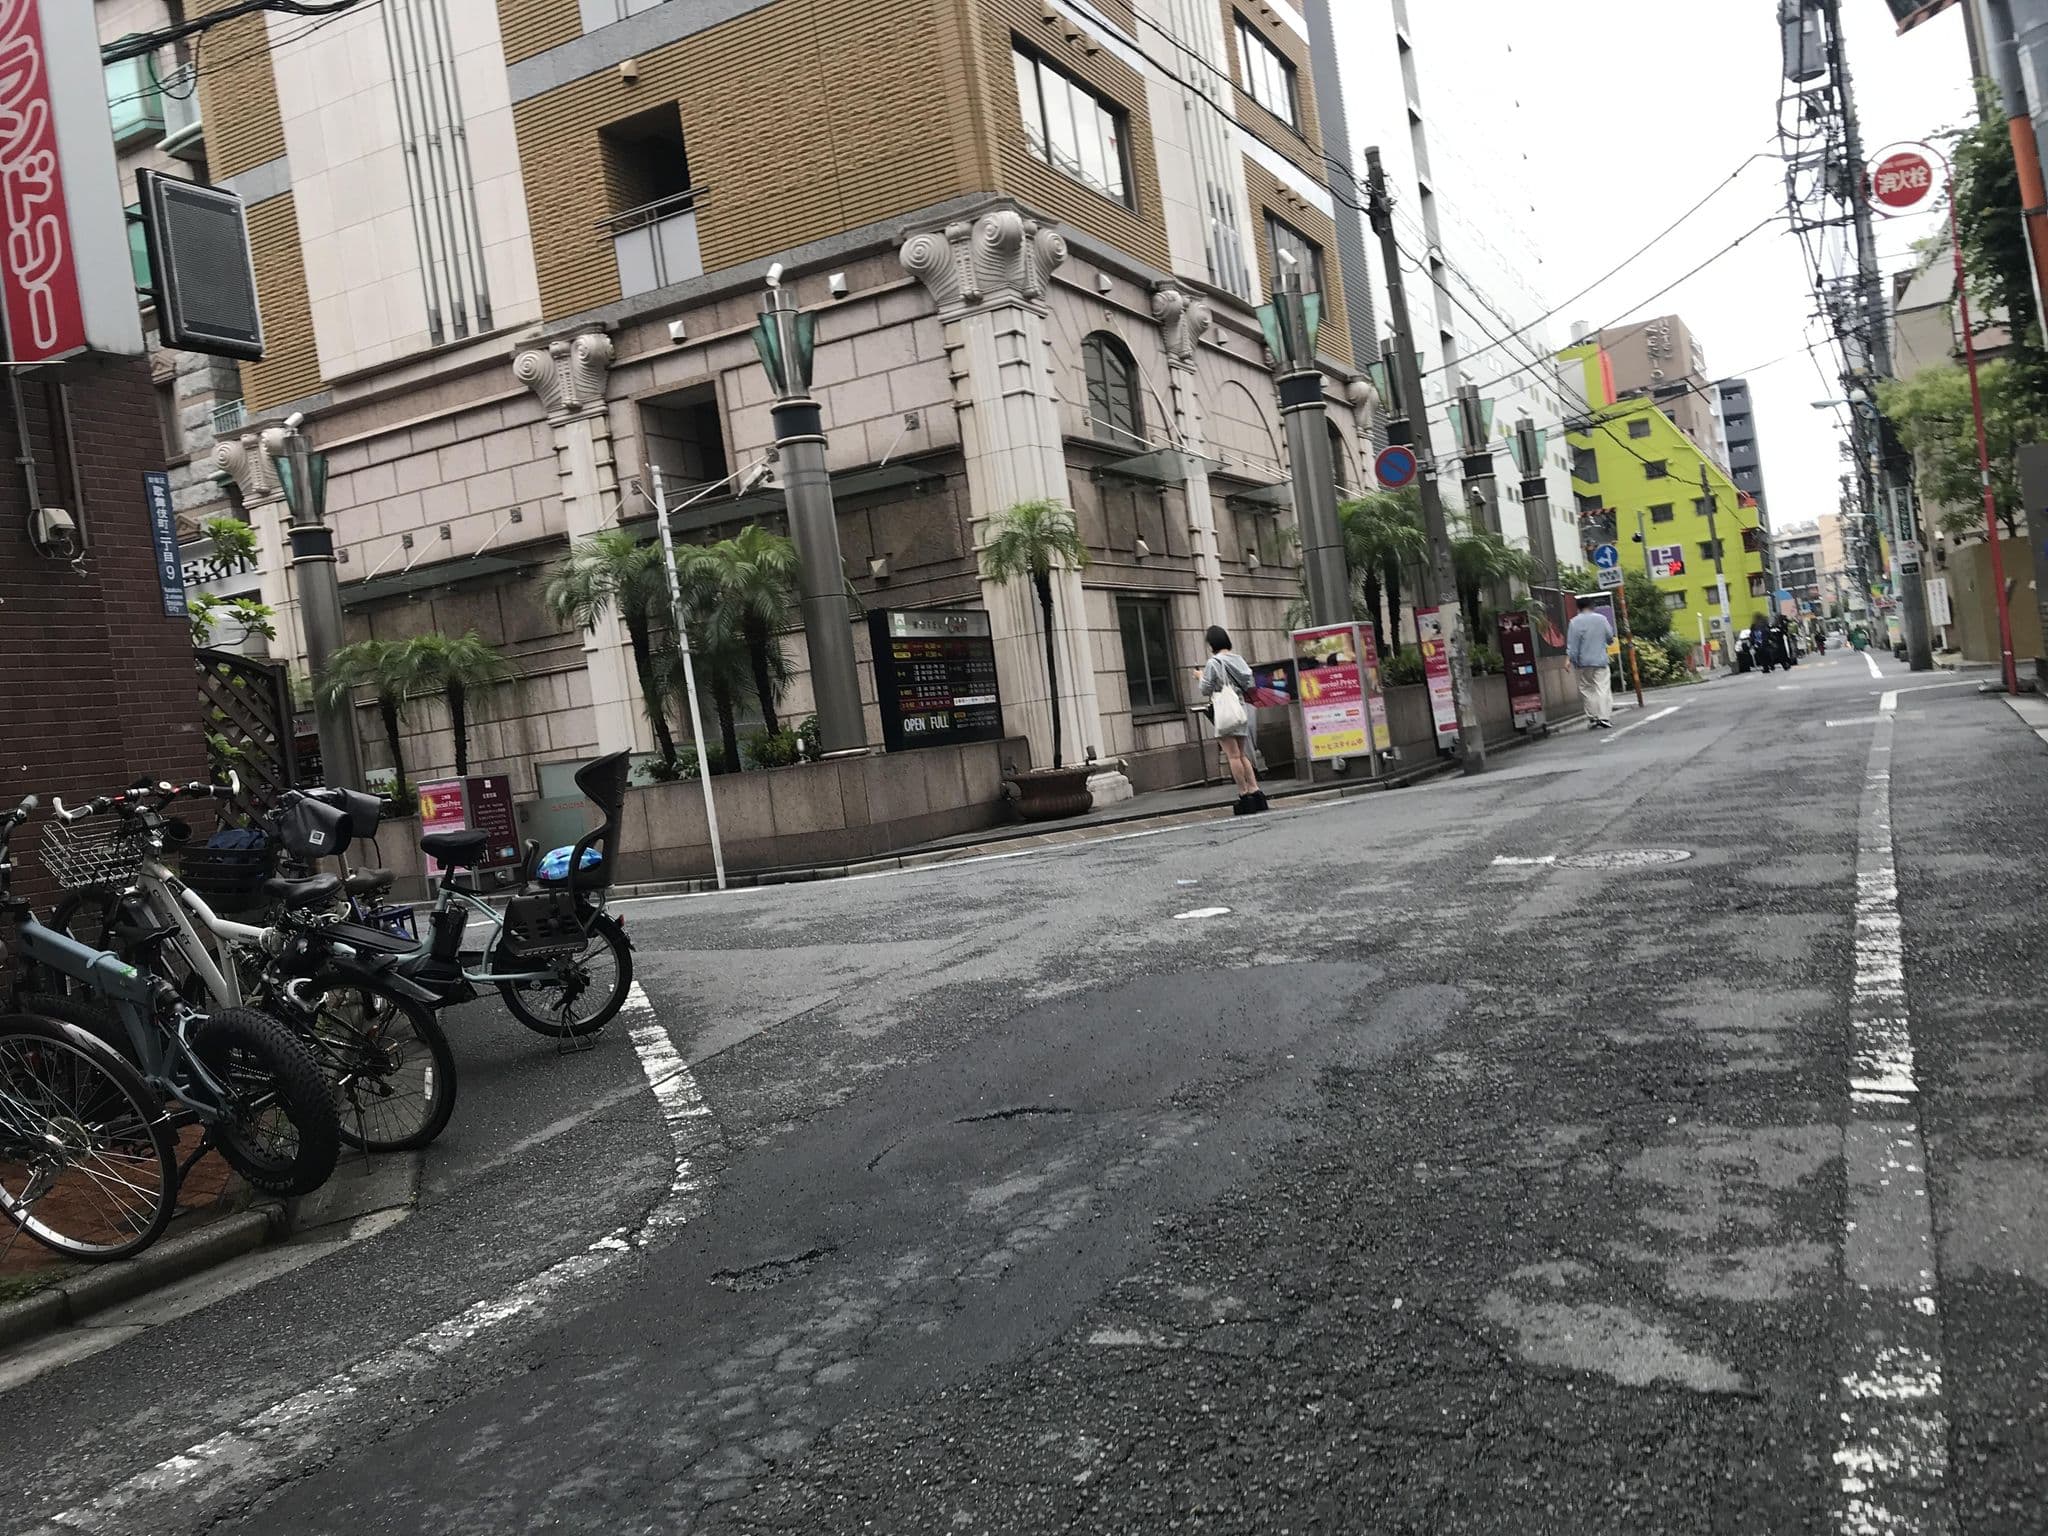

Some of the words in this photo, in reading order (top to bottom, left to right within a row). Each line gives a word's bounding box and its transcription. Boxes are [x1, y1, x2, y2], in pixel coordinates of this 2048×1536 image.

[1878, 165, 1930, 195] 消火栓
[1658, 319, 1673, 358] HOTEL
[904, 717, 926, 732] OPEN
[930, 715, 949, 729] FULL
